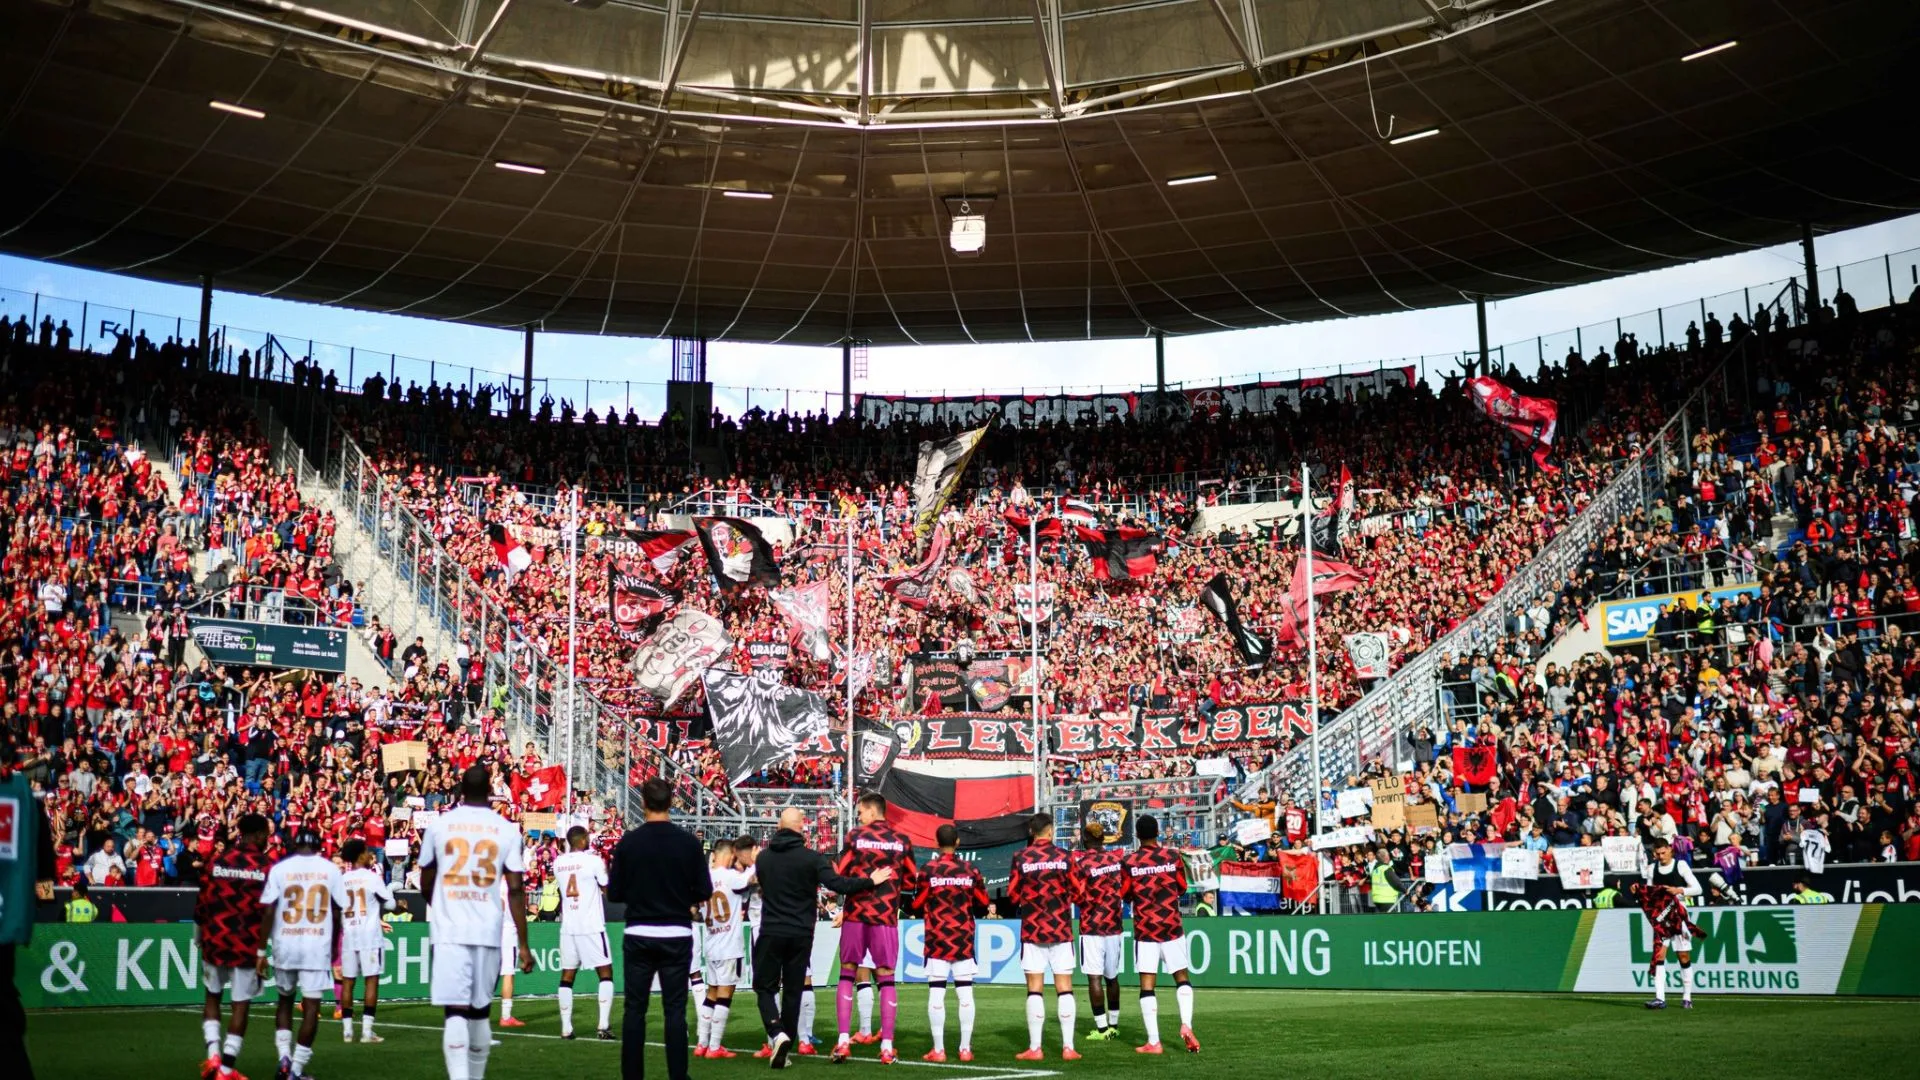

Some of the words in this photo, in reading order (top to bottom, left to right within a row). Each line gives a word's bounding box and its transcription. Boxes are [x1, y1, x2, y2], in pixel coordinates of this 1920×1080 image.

[1607, 607, 1658, 635] SAP
[223, 634, 241, 643] pre
[223, 642, 247, 650] zero
[256, 643, 275, 652] Arena
[927, 702, 1316, 753] LEVERKUSEN
[1377, 777, 1399, 790] FLO
[1286, 815, 1302, 830] 20
[856, 839, 904, 851] Barmenia
[1804, 839, 1818, 857] 17
[443, 837, 498, 888] 23
[1022, 860, 1067, 873] Barmenia
[1723, 853, 1736, 866] 17
[213, 866, 266, 881] Barmenia
[1131, 862, 1176, 876] Barmenia
[566, 873, 579, 898] 4
[930, 876, 973, 887] Barmenia
[282, 884, 329, 924] 30
[1229, 928, 1331, 976] RING
[1363, 940, 1481, 966] ILSHOFEN
[40, 941, 89, 993] &
